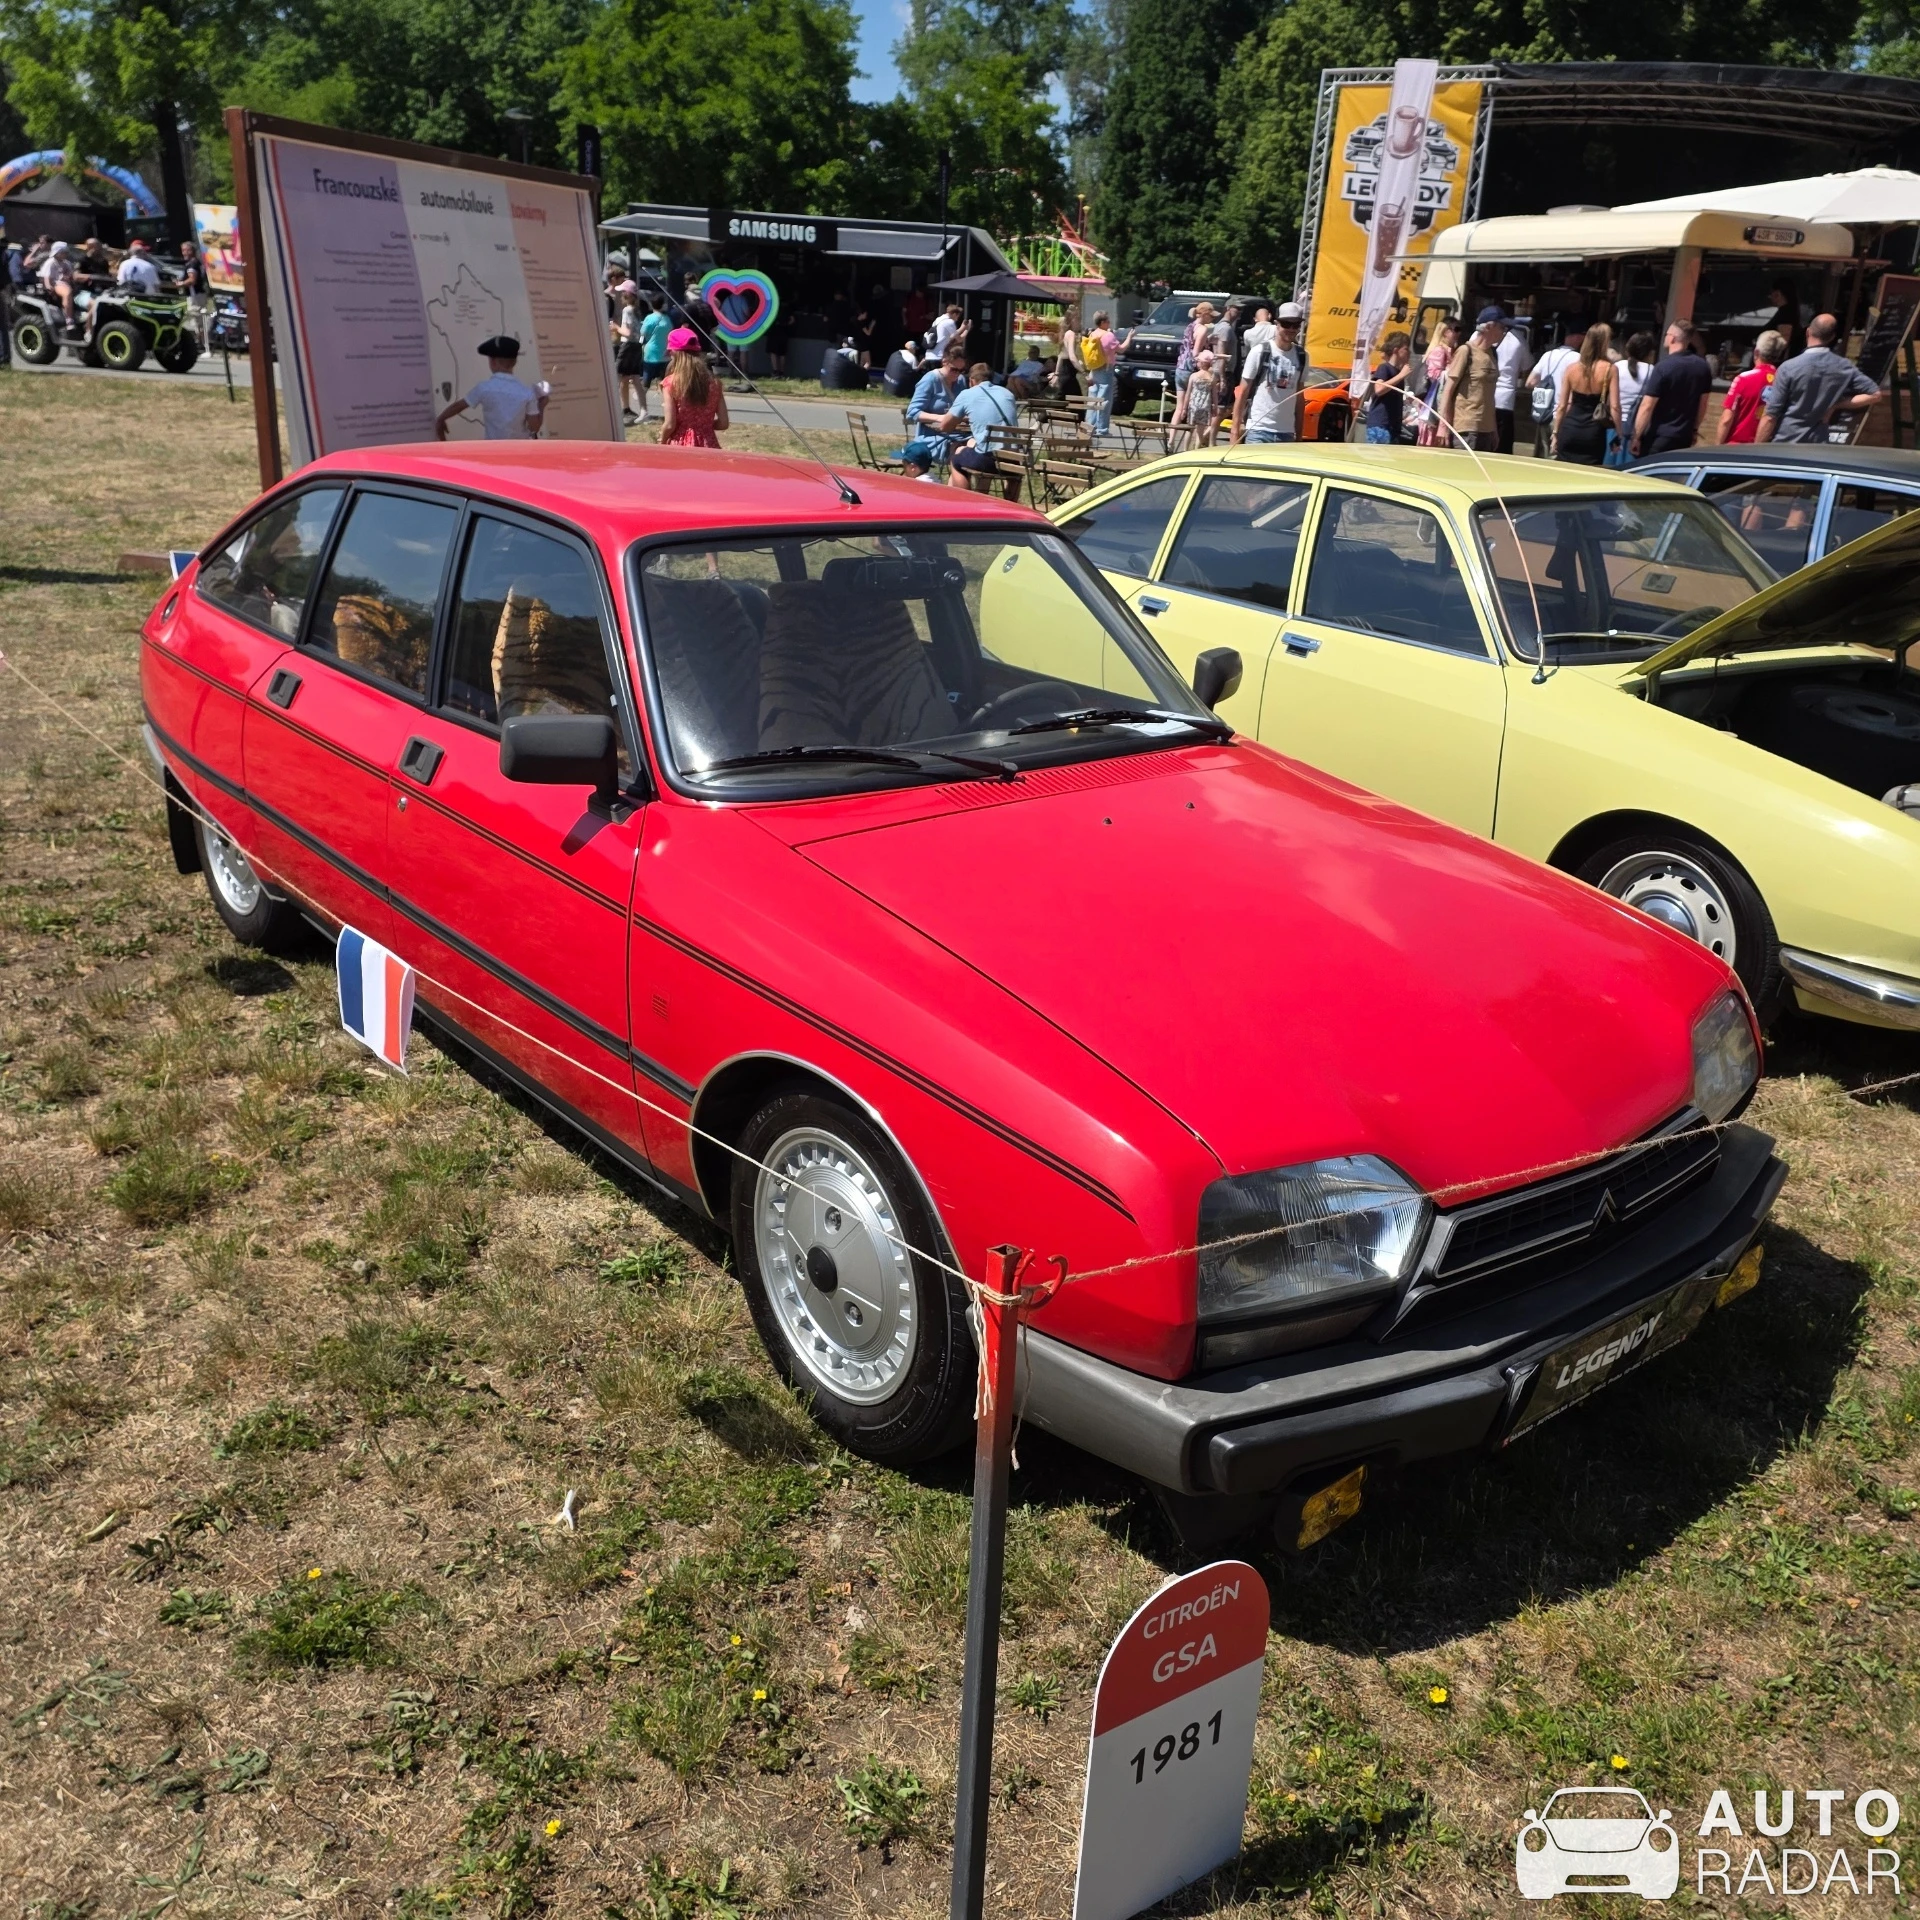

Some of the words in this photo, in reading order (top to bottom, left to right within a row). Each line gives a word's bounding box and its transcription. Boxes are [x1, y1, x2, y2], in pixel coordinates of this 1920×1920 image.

[313, 168, 398, 203] Francouzské
[420, 189, 494, 216] automobilové
[1346, 178, 1449, 204] LEDY
[729, 219, 816, 243] SAMSUNG
[1556, 1311, 1664, 1389] LEGENDY
[1143, 1580, 1241, 1639] CITROËN
[1152, 1633, 1217, 1683] GSA
[1130, 1709, 1223, 1785] 1981
